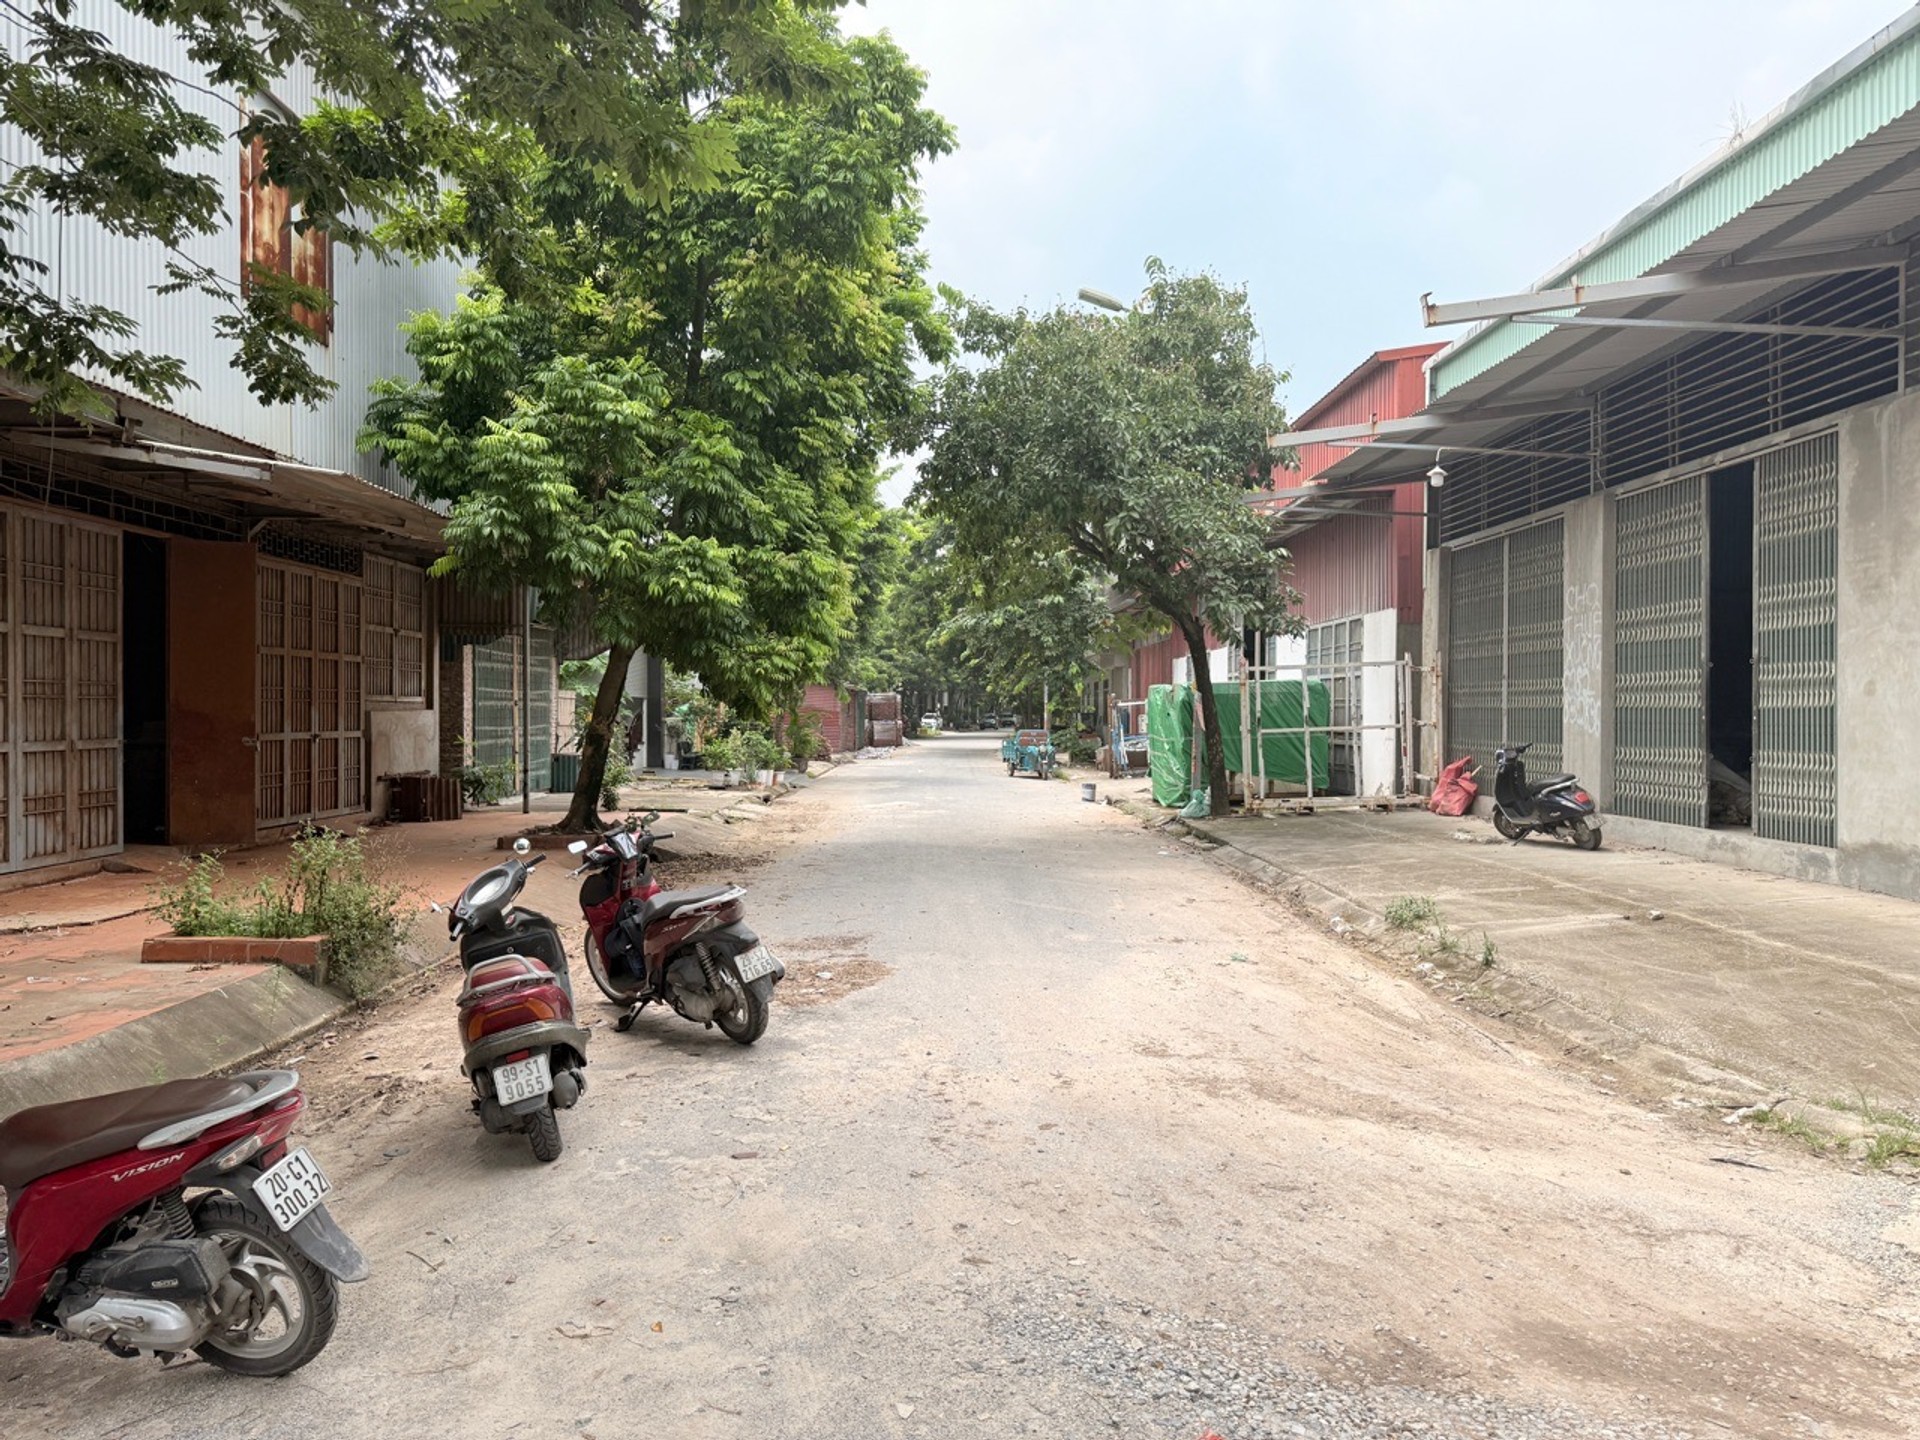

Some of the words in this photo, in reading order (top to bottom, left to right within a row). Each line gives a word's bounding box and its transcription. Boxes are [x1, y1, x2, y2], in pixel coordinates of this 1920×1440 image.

[1566, 583, 1600, 612] CHO
[502, 1059, 541, 1084] 99-S1
[505, 1075, 545, 1101] 9055
[110, 1152, 185, 1182] VISION
[265, 1155, 309, 1199] 20-G1
[274, 1172, 329, 1224] 300.32
